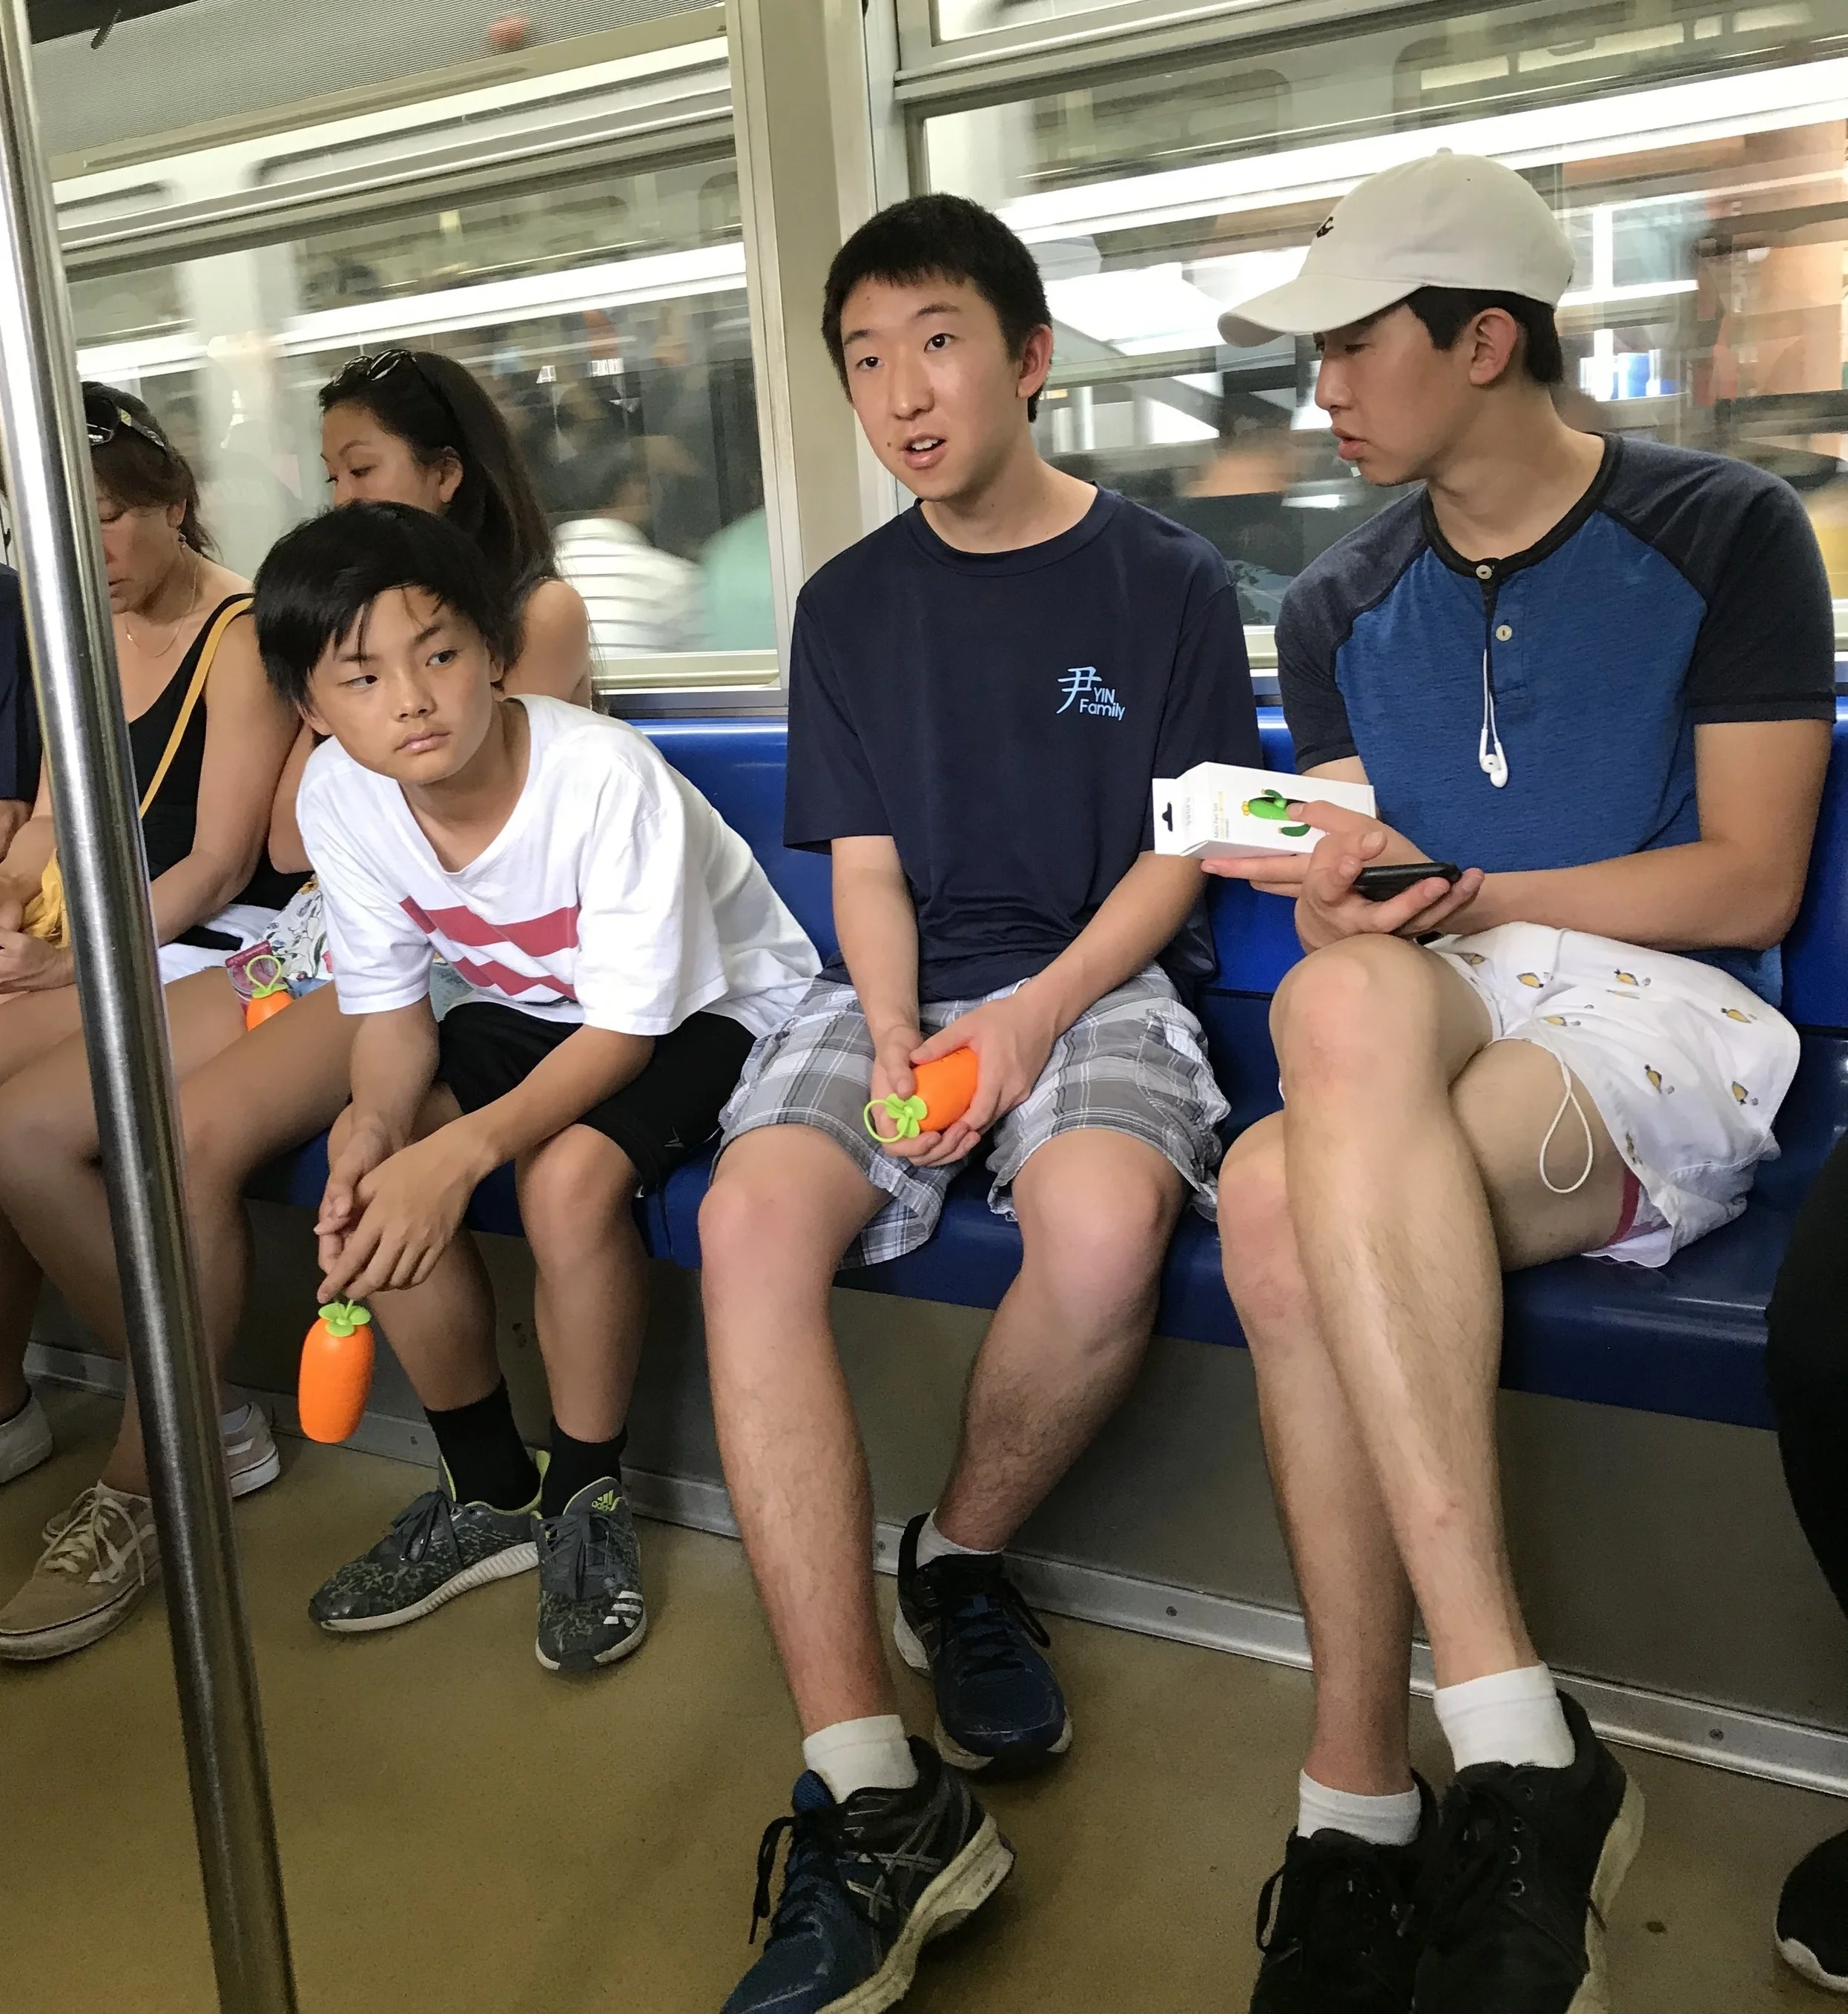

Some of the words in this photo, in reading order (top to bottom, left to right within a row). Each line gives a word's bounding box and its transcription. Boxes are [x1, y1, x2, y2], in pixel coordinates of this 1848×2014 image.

[1056, 666, 1103, 714] 尹
[1093, 687, 1115, 704] YIN
[1079, 699, 1126, 721] Family
